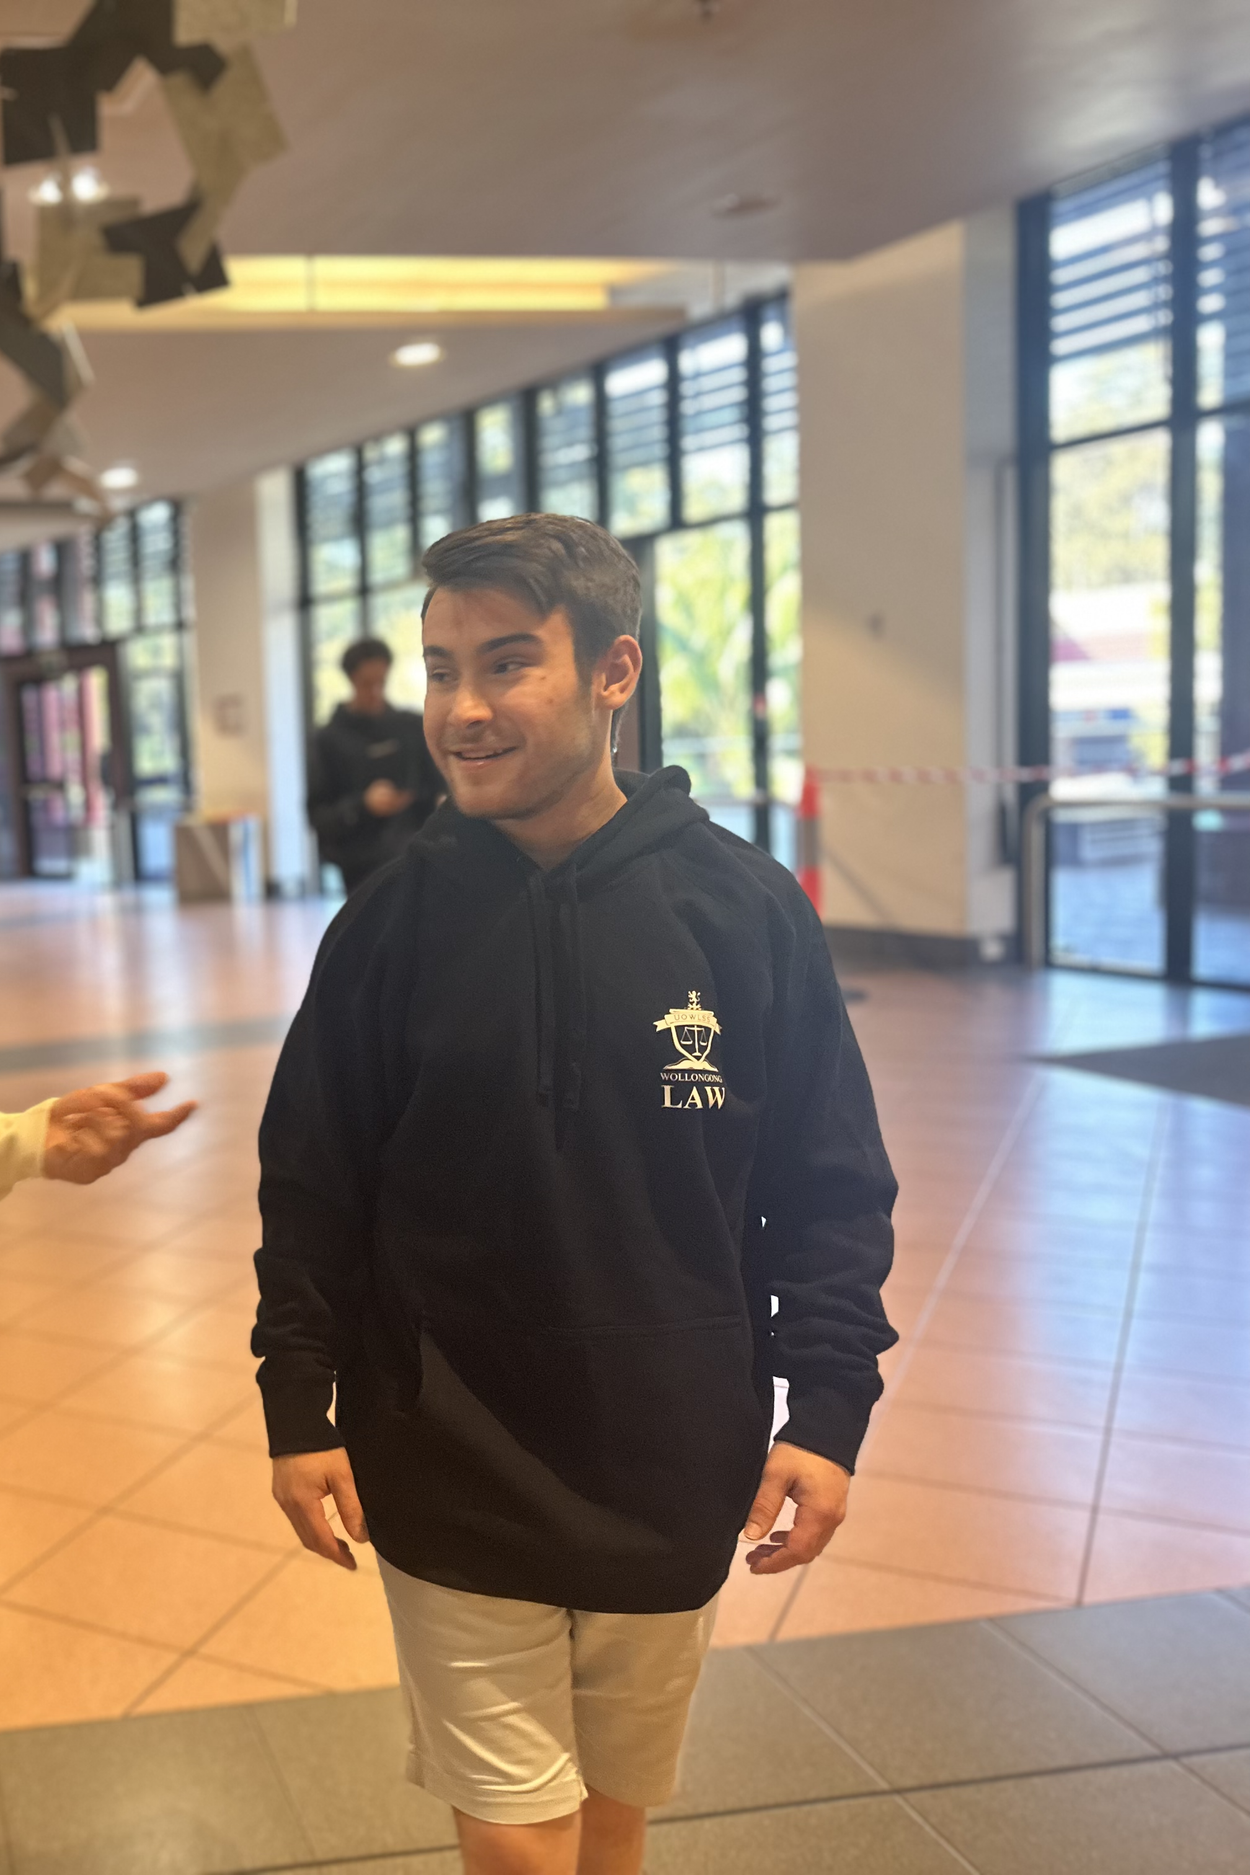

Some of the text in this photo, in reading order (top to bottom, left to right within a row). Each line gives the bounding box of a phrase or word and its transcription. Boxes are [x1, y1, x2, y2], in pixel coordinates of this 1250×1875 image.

[674, 1013, 711, 1023] UOWLSS
[660, 1072, 723, 1083] WOLLONGONG
[661, 1085, 726, 1109] LAW
